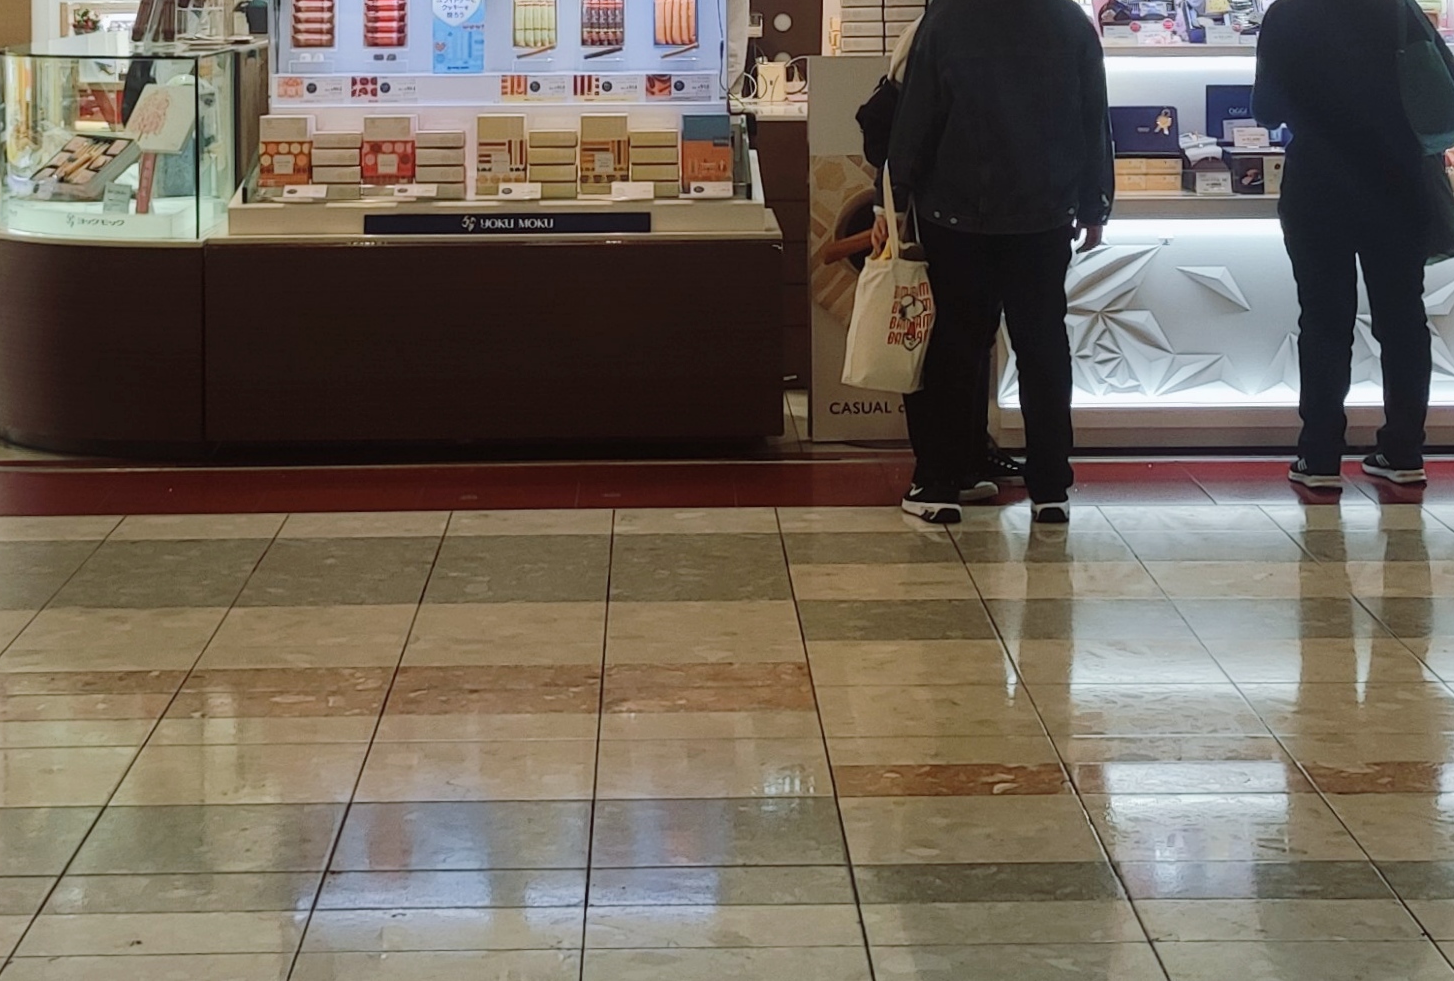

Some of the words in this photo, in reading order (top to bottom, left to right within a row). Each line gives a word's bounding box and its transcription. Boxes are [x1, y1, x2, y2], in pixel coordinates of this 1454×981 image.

[480, 218, 514, 229] YOKU
[518, 218, 554, 229] MOKU
[829, 402, 892, 415] CASUAL
